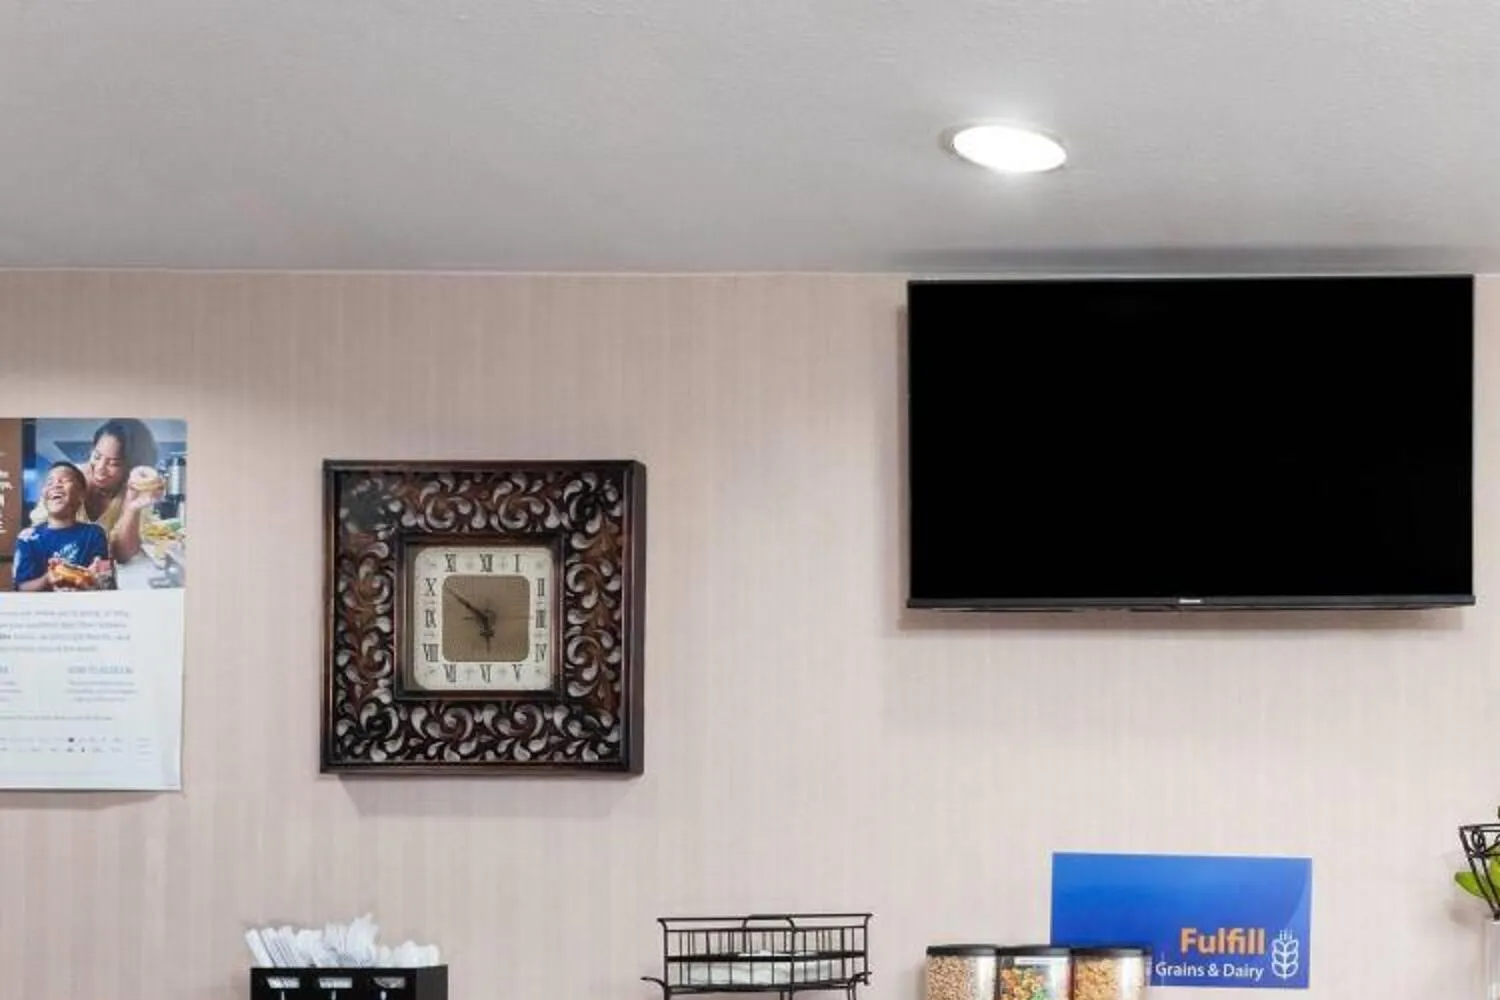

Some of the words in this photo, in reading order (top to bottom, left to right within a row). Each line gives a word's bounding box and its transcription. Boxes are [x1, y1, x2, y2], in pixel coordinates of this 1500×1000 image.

[1180, 927, 1265, 955] Fulfill
[1155, 961, 1205, 978] Grains
[1207, 962, 1220, 978] &
[1223, 963, 1264, 982] Dairy
